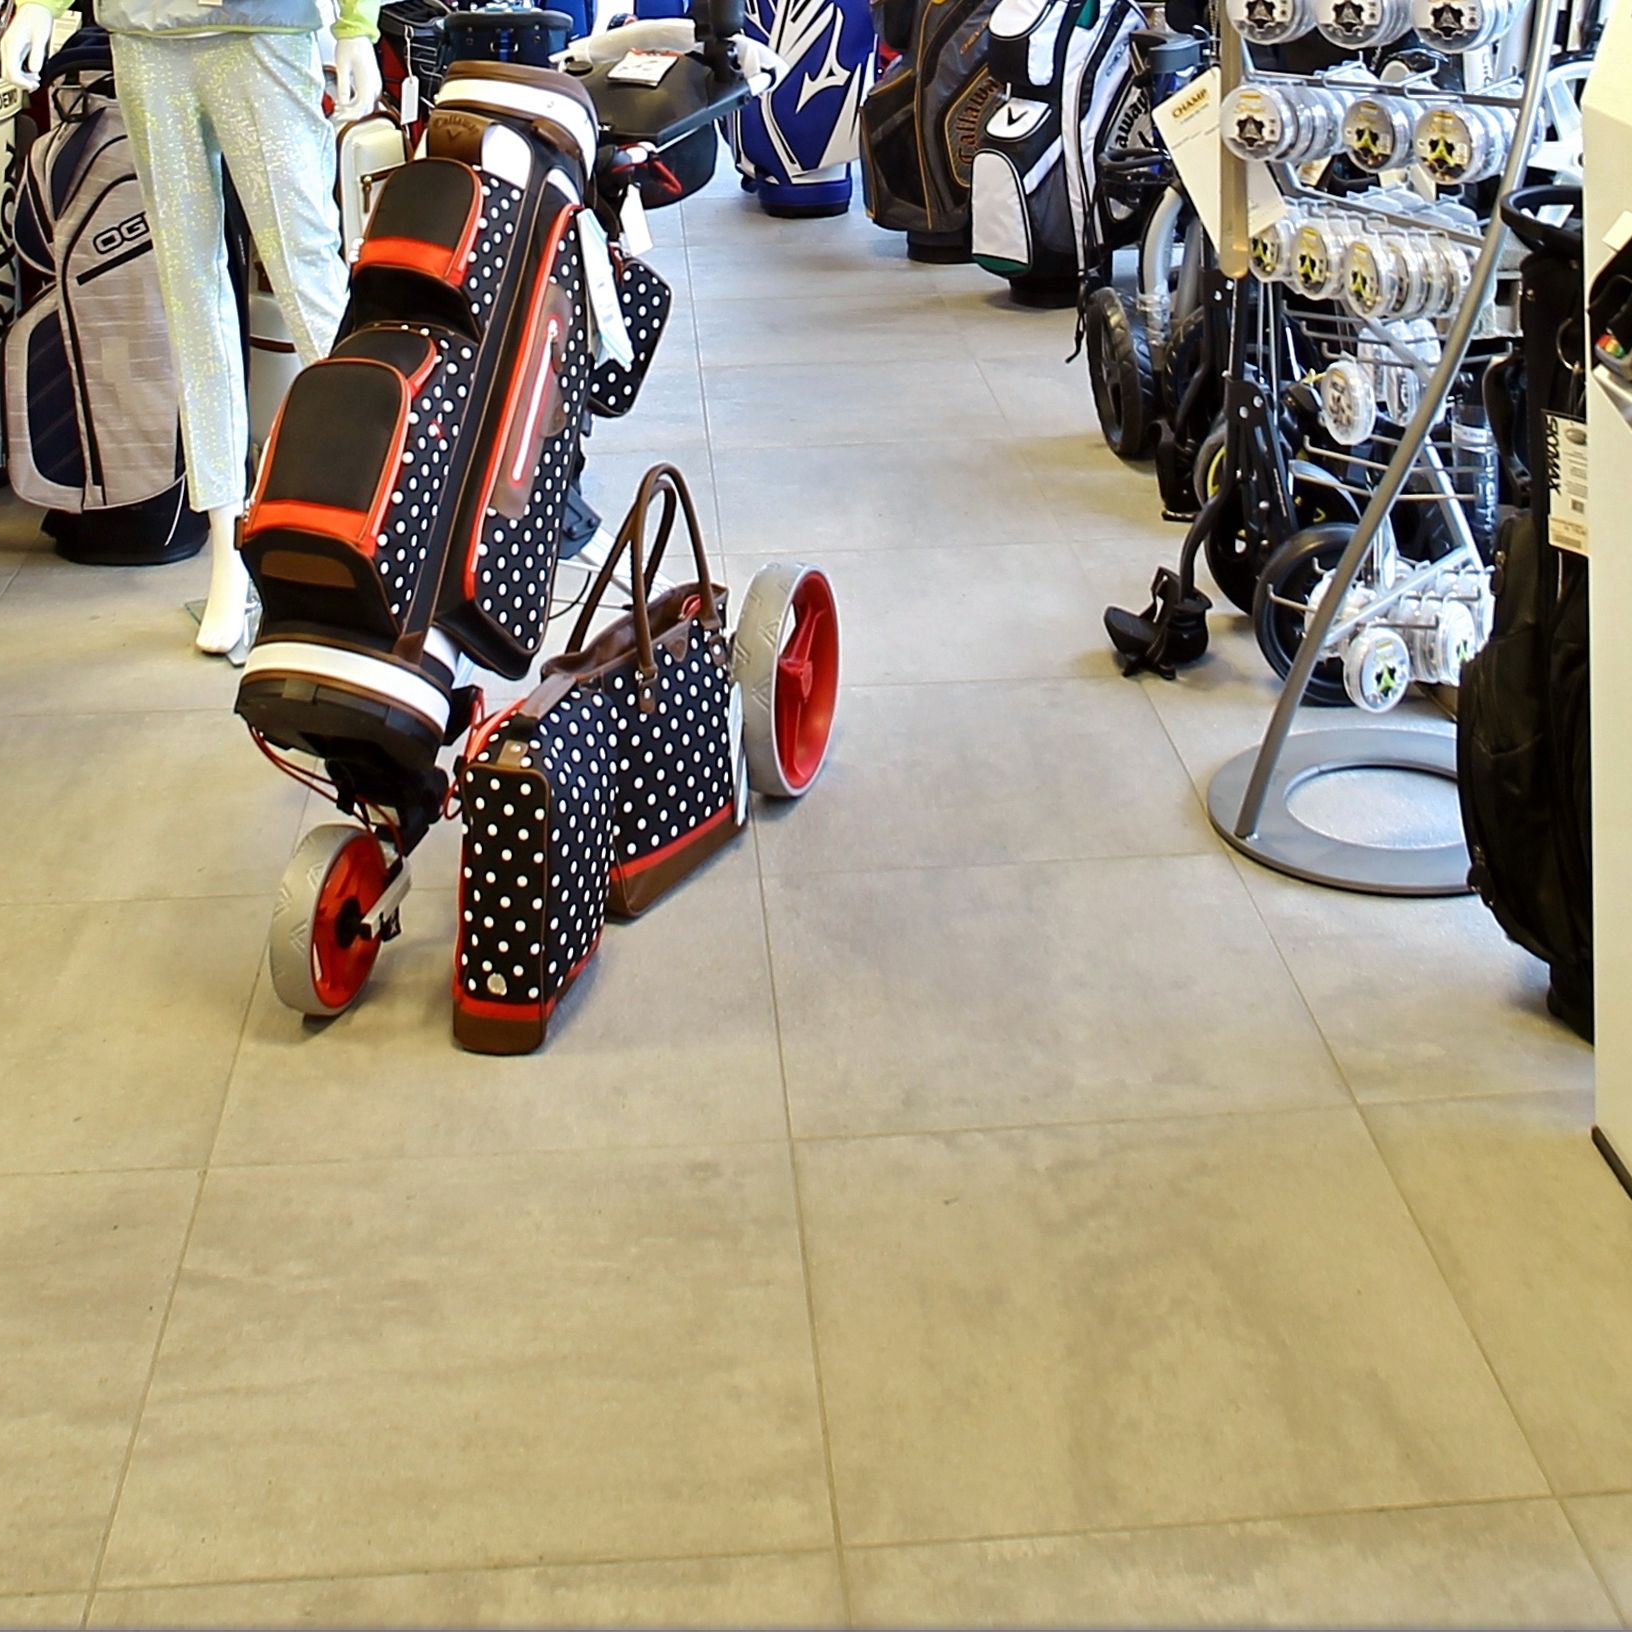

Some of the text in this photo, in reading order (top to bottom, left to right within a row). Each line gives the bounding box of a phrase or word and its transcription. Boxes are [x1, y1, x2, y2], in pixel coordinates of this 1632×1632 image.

[956, 78, 1001, 166] Callawa
[1114, 89, 1150, 149] away
[1171, 87, 1209, 120] CHAMP
[92, 210, 151, 255] OG
